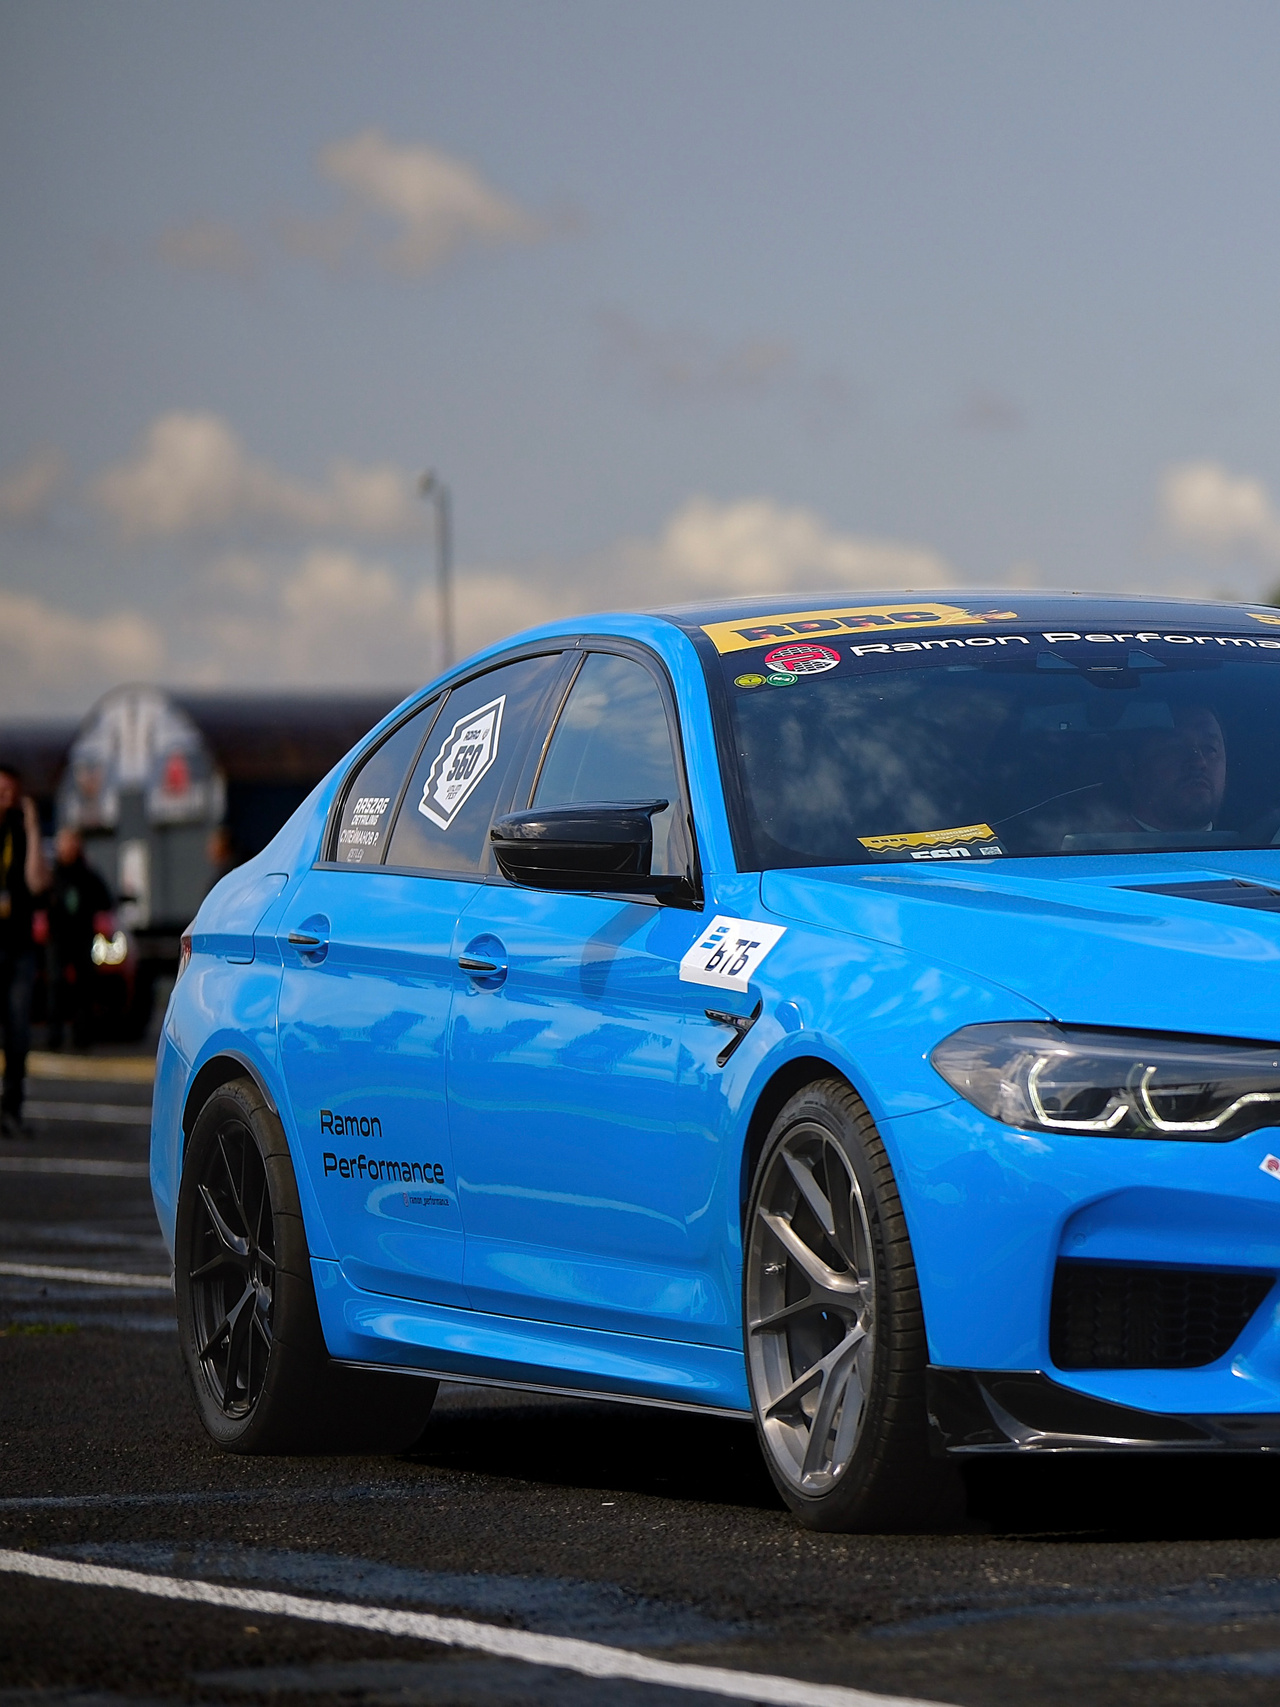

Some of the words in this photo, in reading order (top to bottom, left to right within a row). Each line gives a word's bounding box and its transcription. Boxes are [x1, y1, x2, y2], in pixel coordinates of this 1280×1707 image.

[730, 611, 942, 642] RDRC
[849, 634, 1030, 657] Ramon
[446, 743, 484, 782] 560
[319, 1109, 383, 1138] Ramon
[322, 1151, 446, 1185] Performance
